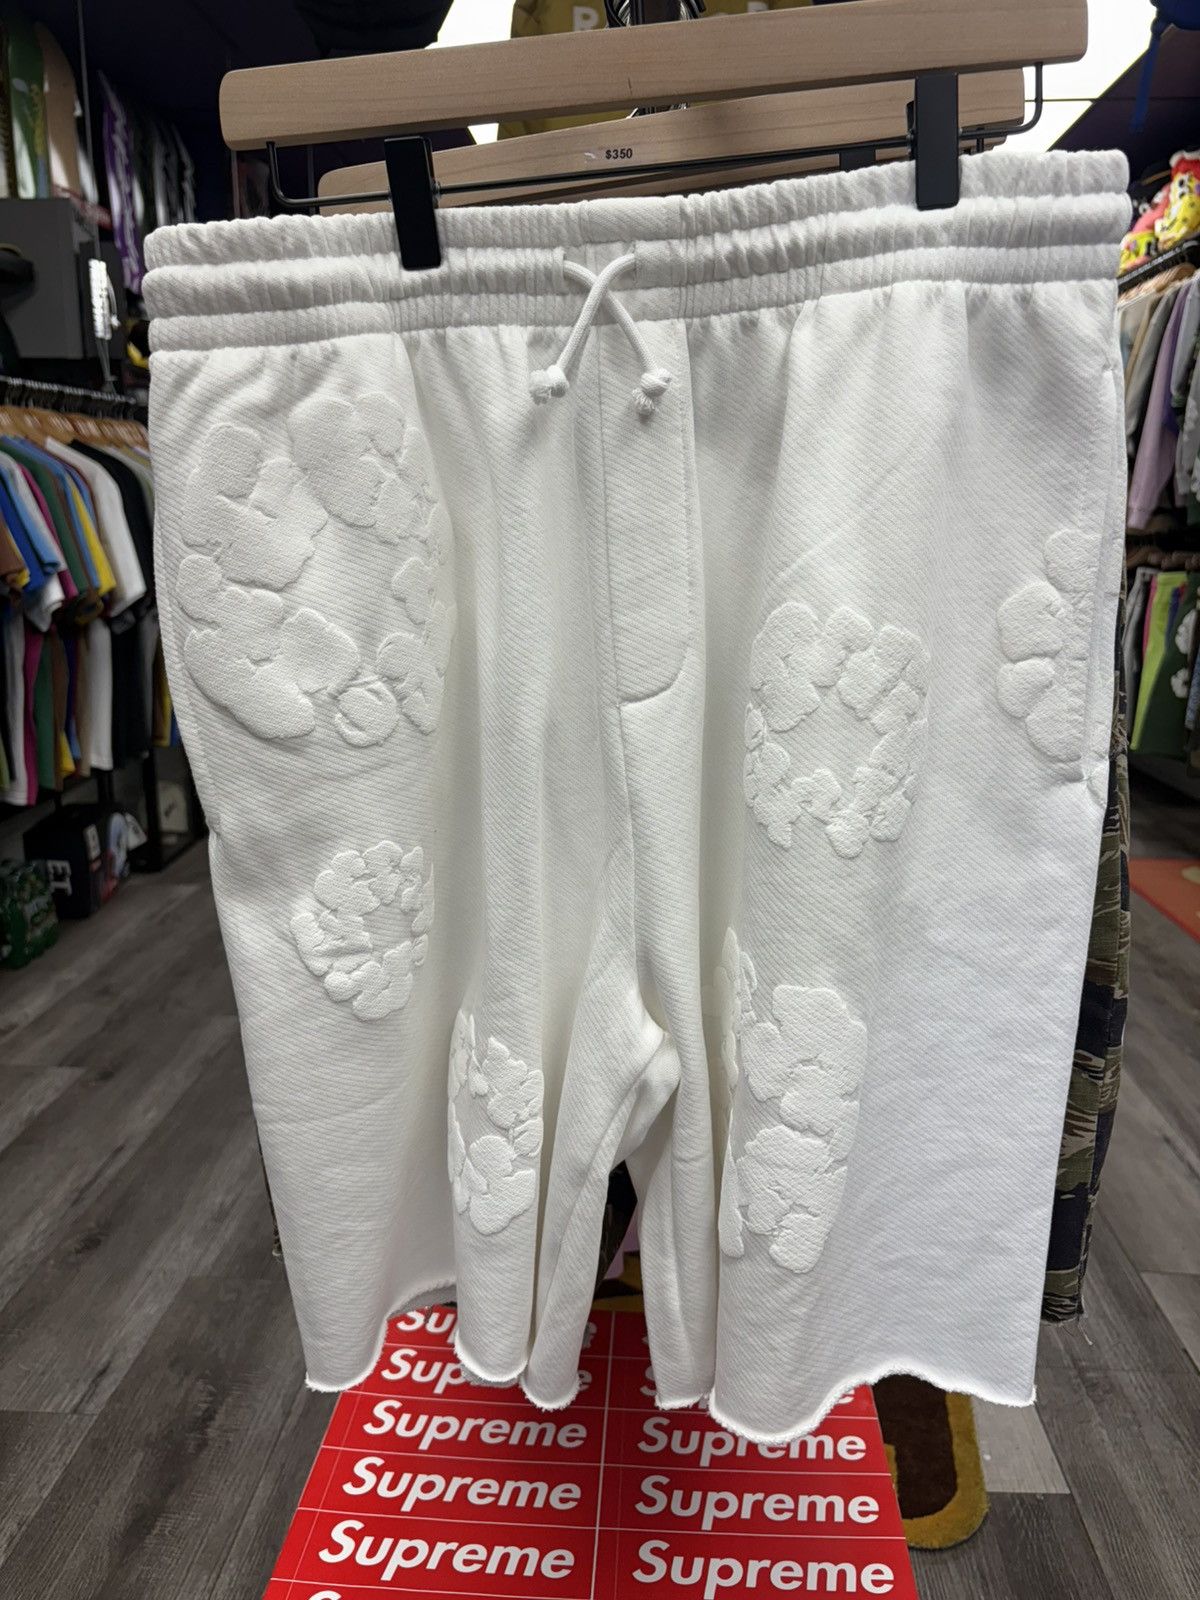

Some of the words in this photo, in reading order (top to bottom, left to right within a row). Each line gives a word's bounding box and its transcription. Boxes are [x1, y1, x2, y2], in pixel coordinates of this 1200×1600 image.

[605, 148, 633, 159] $350
[363, 1400, 588, 1450] Supreme
[343, 1457, 581, 1511] Supreme
[635, 1475, 879, 1531] Supreme
[319, 1520, 575, 1581] Supreme
[632, 1540, 895, 1600] Supreme
